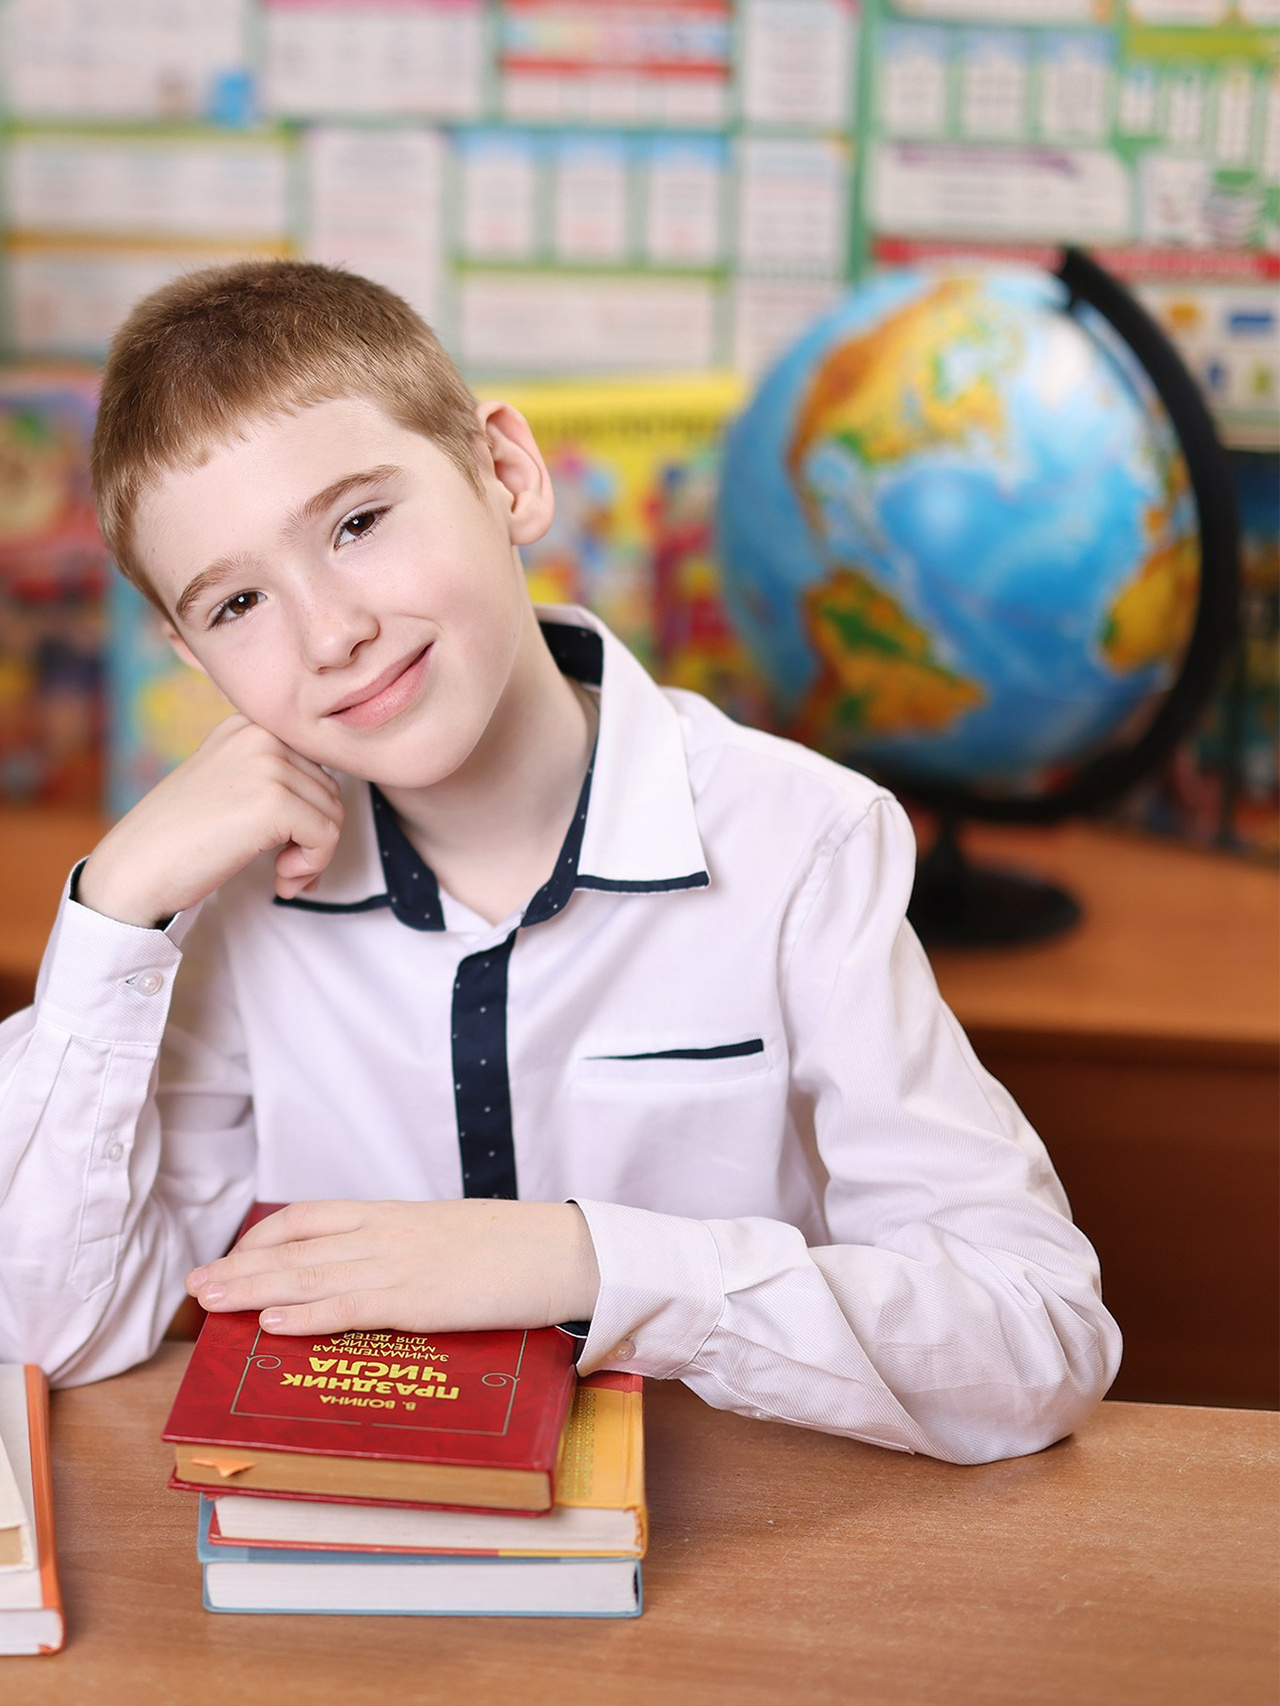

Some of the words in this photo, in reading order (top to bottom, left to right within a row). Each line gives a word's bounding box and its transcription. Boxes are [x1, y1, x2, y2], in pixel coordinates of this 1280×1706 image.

[330, 1338, 436, 1353] МАТЕМАТИКА
[343, 1332, 392, 1343] ДЕТЕЙ
[396, 1335, 428, 1345] ДЛЯ
[312, 1344, 450, 1362] ЗАНИМАТЕЛЬНАЯ
[308, 1356, 448, 1383] ЧИСЛА
[280, 1372, 460, 1400] ПРАЗДНИК
[319, 1394, 396, 1411] ВОЛИНА
[402, 1400, 417, 1412] В.
